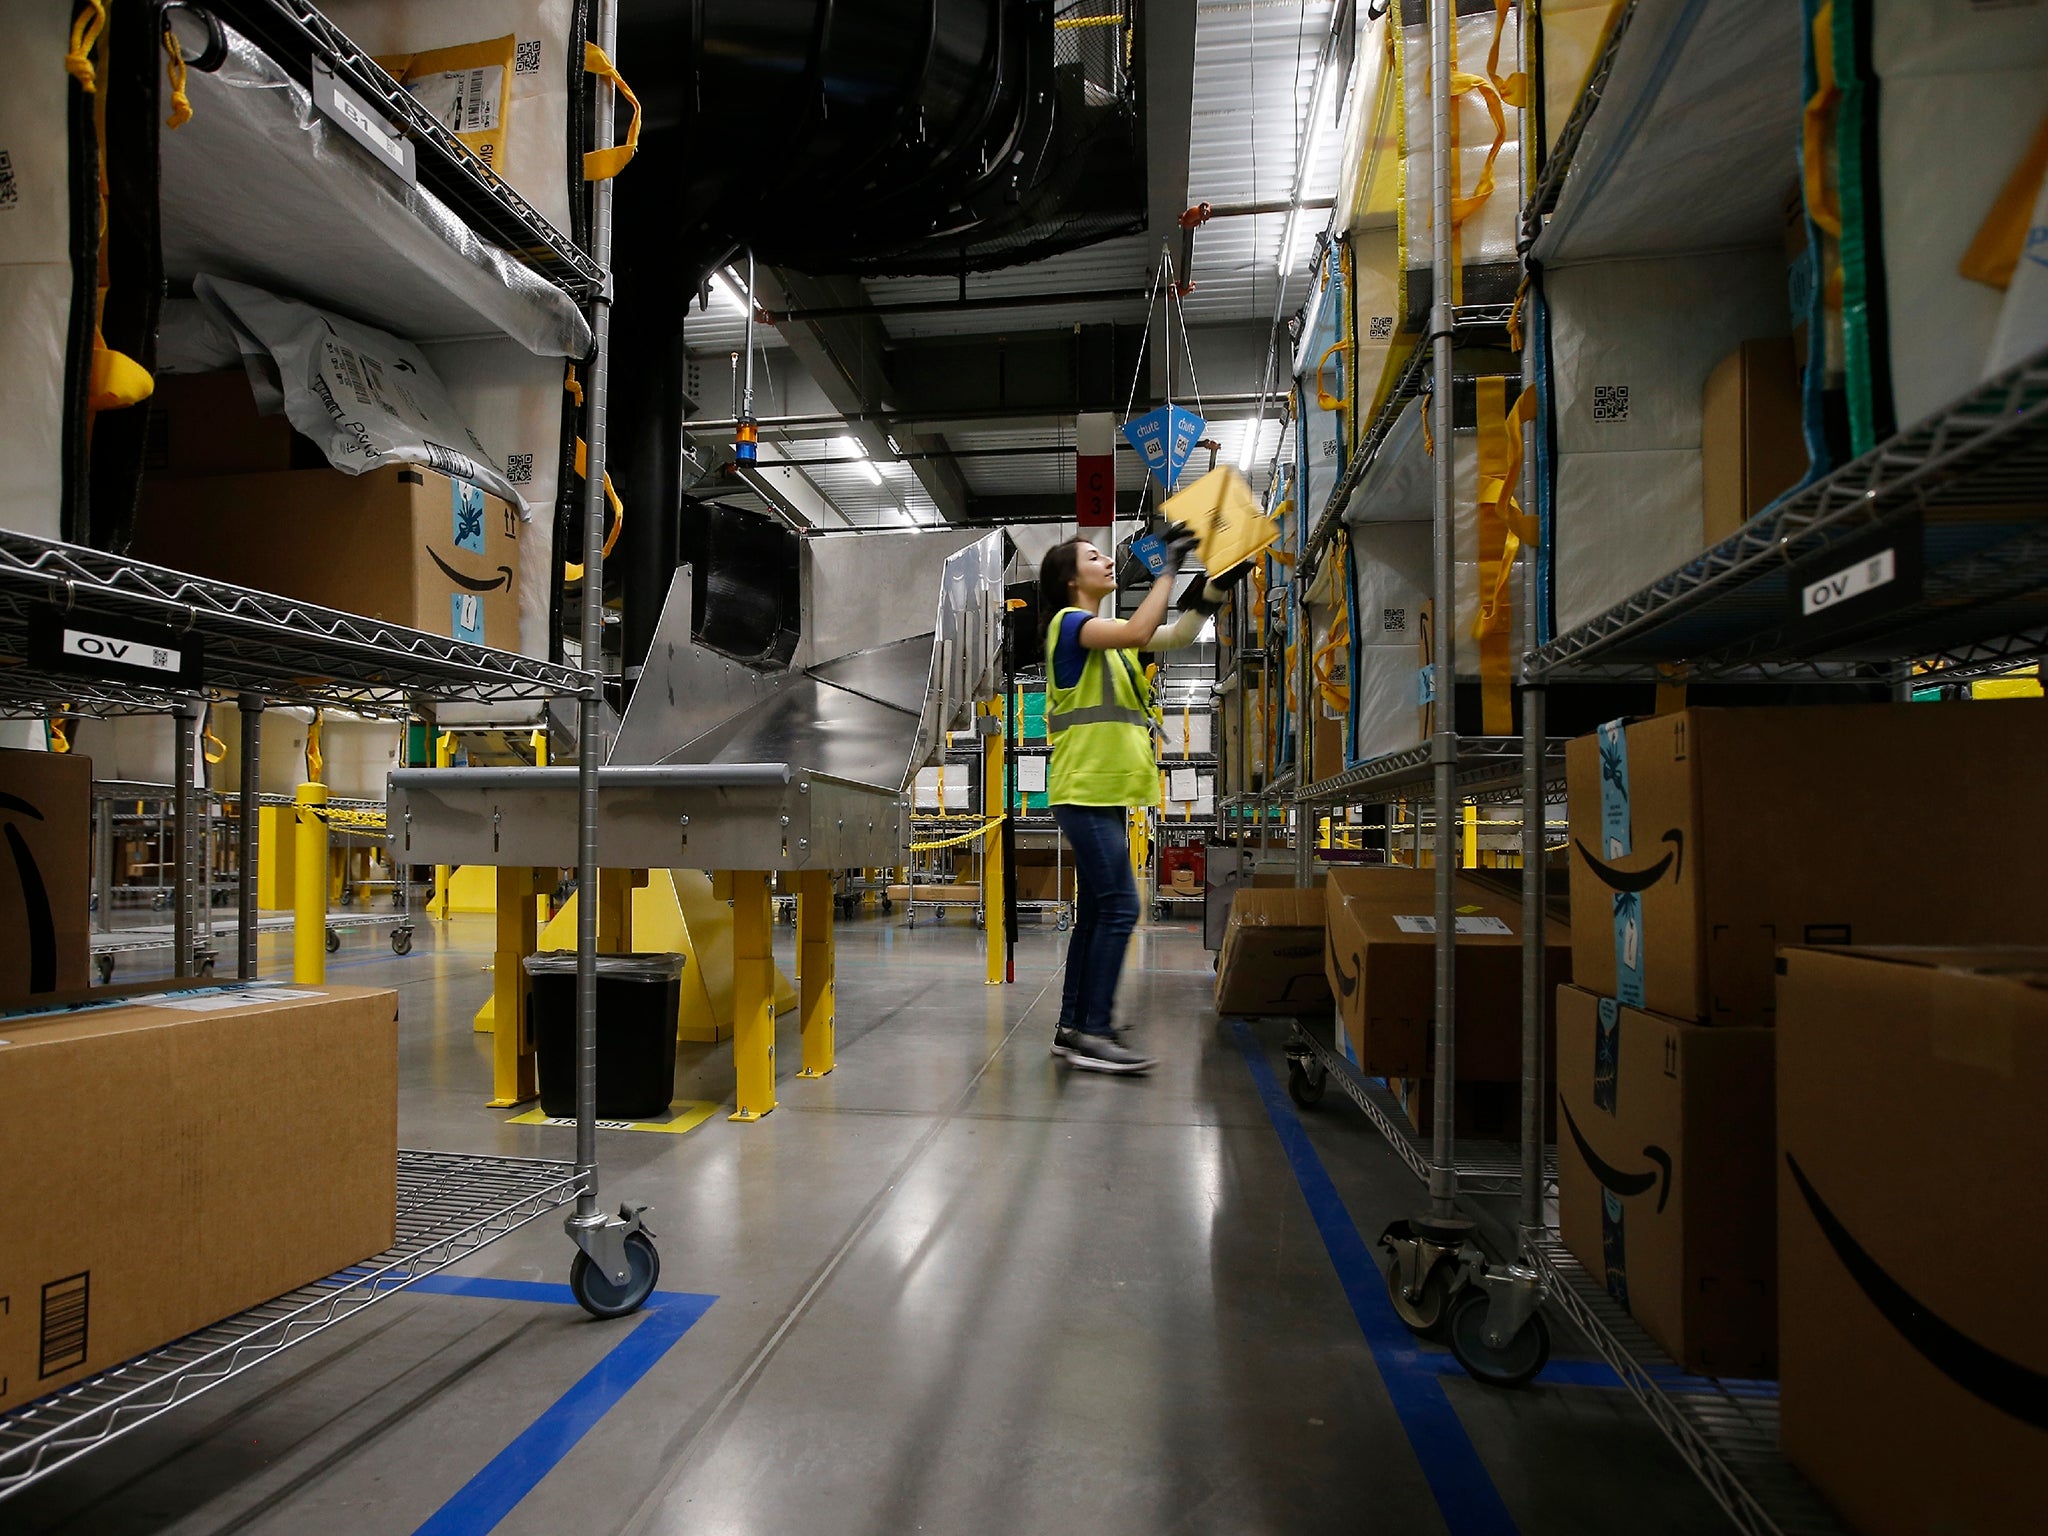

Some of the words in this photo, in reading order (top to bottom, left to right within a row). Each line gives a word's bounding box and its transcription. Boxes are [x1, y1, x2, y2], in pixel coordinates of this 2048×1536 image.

[344, 102, 368, 132] B1
[480, 144, 494, 169] M9
[1136, 421, 1160, 438] chute
[1178, 417, 1196, 435] chute
[1146, 441, 1161, 455] G01
[1812, 575, 1849, 606] OV
[77, 638, 130, 659] OV
